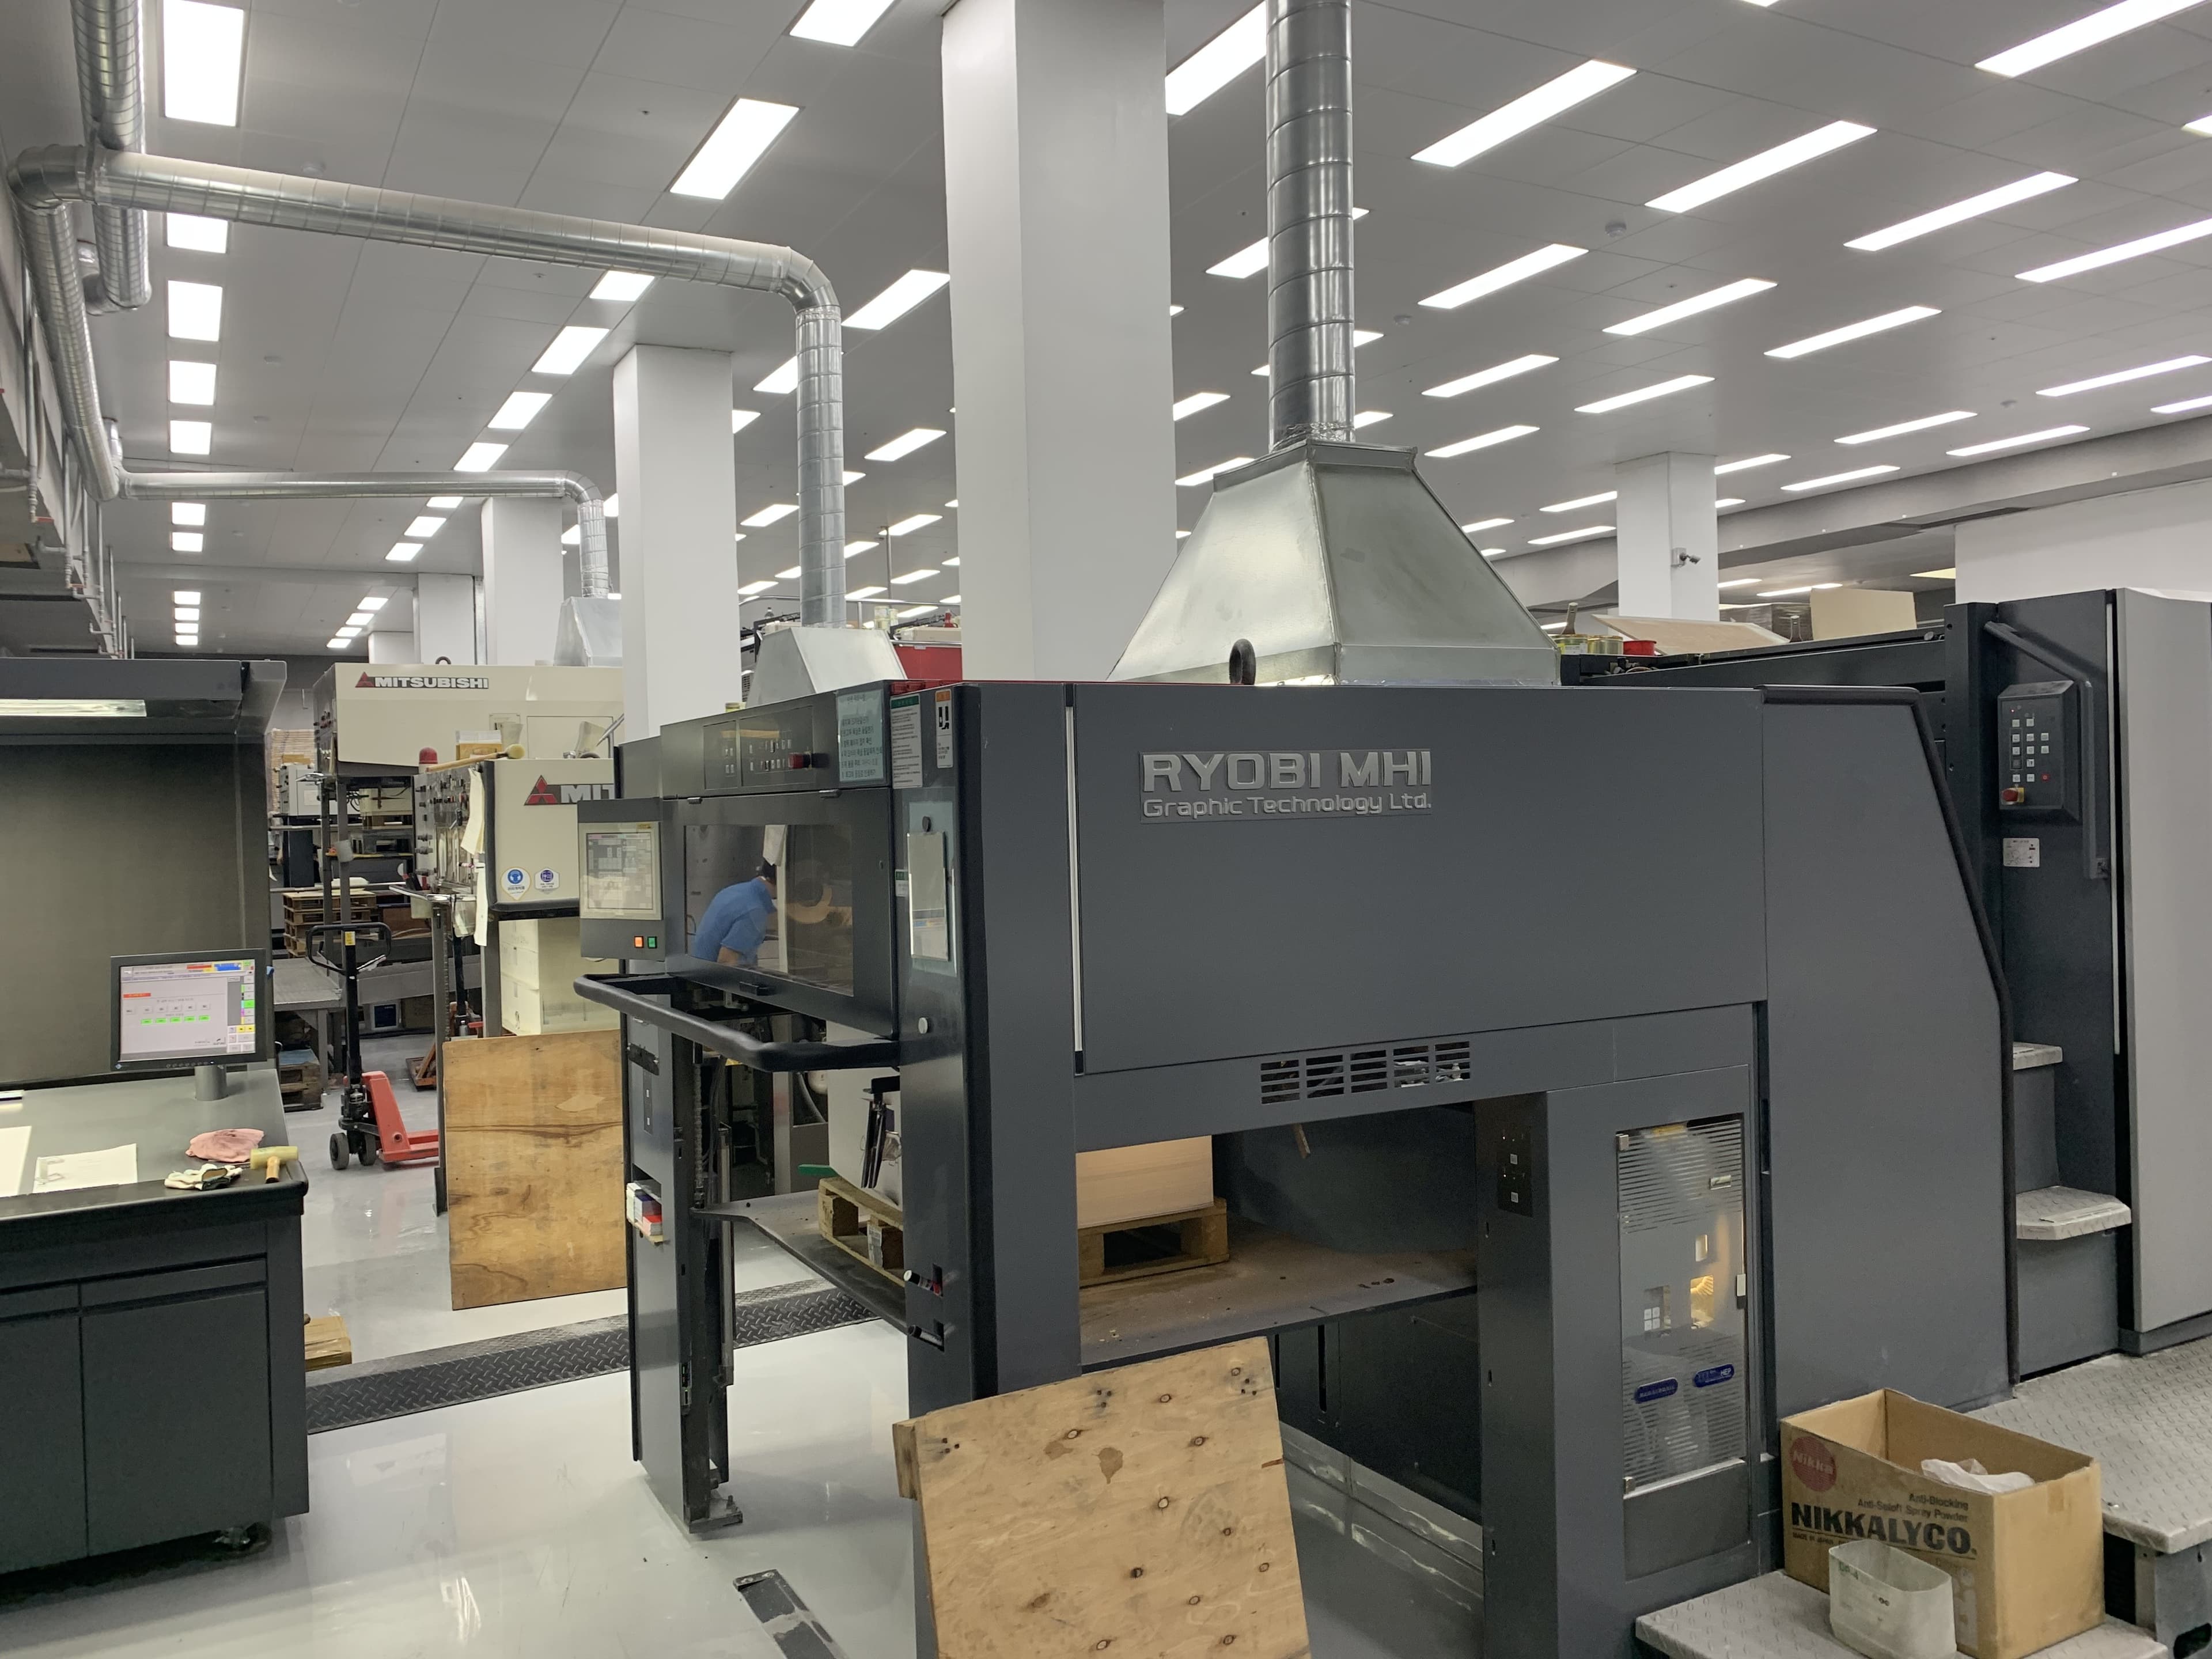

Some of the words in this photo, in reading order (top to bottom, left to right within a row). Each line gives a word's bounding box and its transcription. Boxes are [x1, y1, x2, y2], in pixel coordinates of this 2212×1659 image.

[375, 677, 488, 688] MITSUBISHI
[1143, 752, 1321, 792] RYOBI
[1340, 751, 1432, 788] MHI
[1143, 797, 1243, 819] Graphic
[1247, 794, 1382, 816] Technology
[1389, 792, 1432, 810] Ltd.
[1906, 1505, 1931, 1518] Spray
[1934, 1509, 1968, 1522] Powder
[1909, 1493, 1968, 1512] Anti-Blocking
[1791, 1502, 1971, 1554] NIKKALYCO
